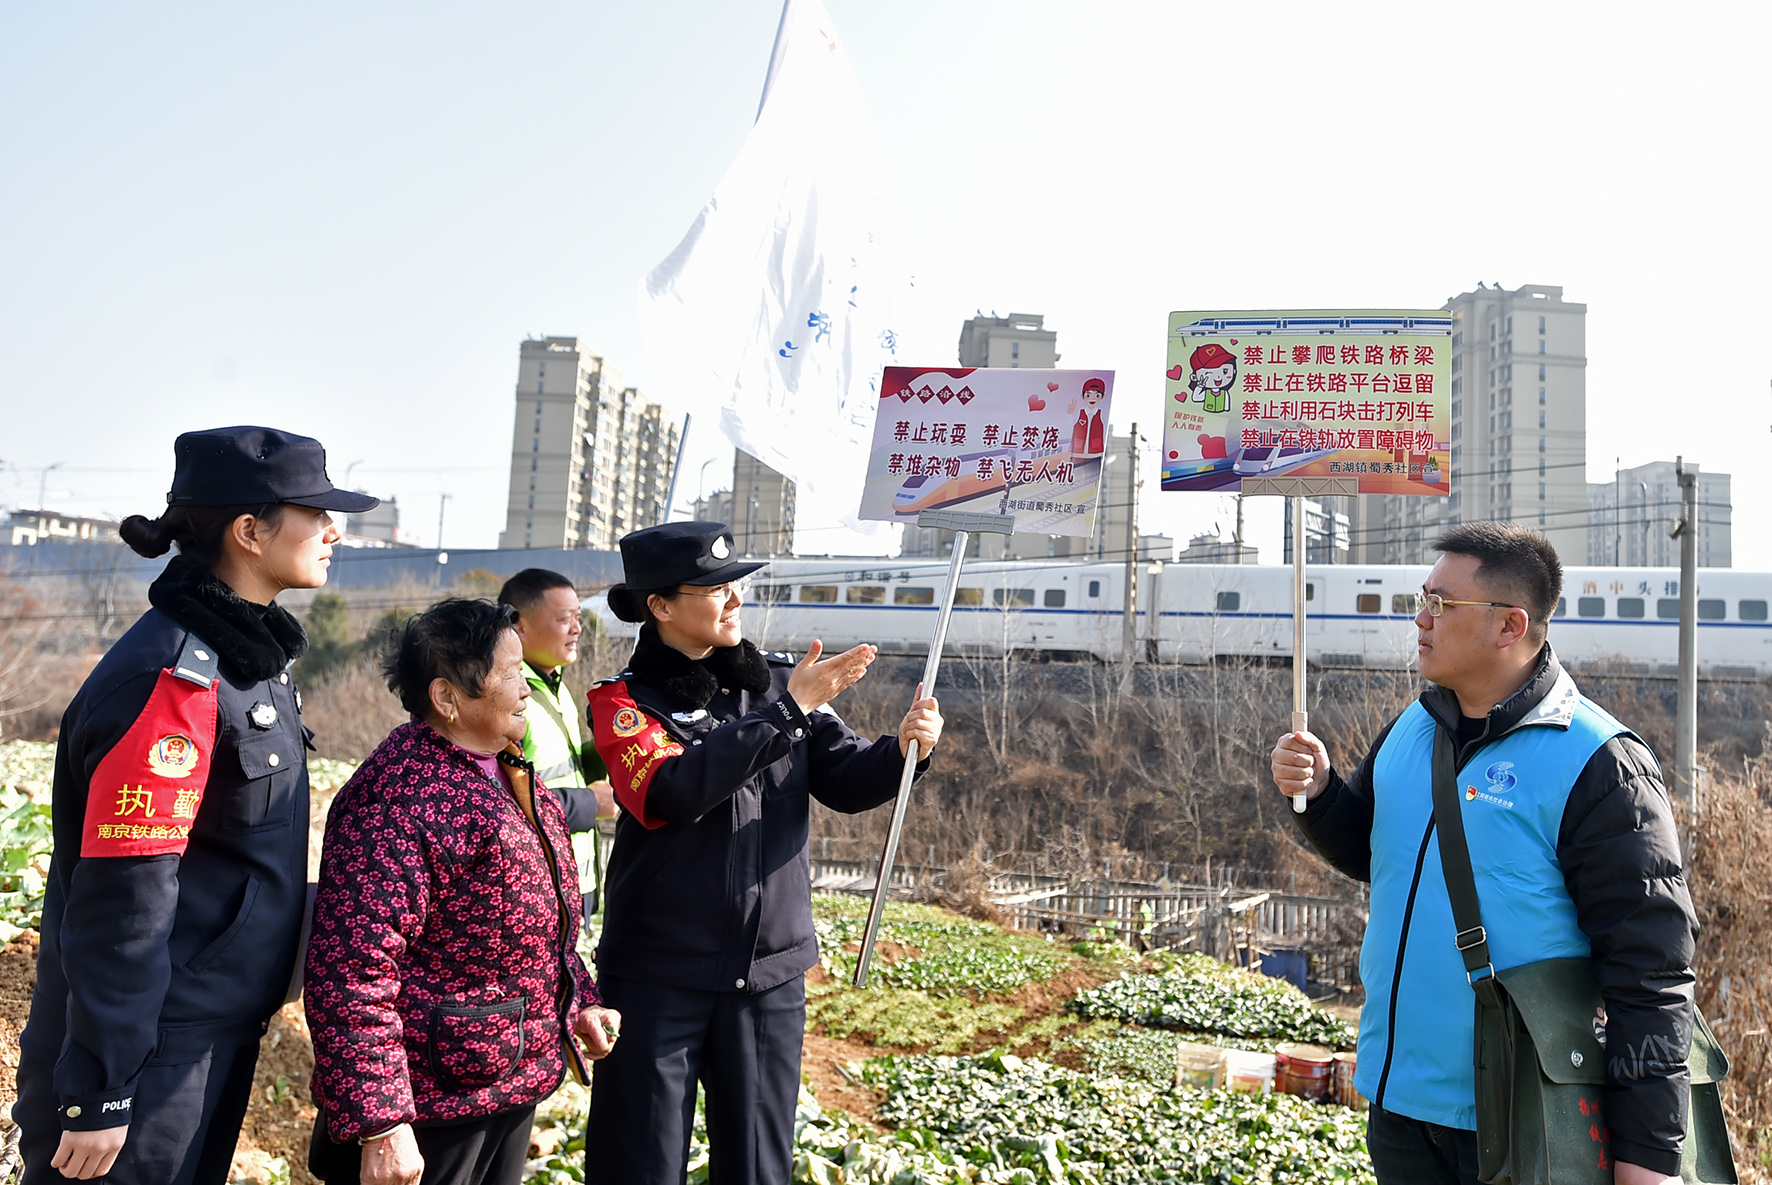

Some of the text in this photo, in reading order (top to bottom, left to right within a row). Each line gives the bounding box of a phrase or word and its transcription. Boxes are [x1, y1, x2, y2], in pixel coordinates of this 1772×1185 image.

[1243, 344, 1434, 366] 禁止攀爬铁路桥梁
[899, 388, 972, 400] 铁路沿线
[1242, 372, 1434, 394] 禁止在铁路平台逗留
[1241, 400, 1434, 422] 禁止利用石块击打列车
[893, 420, 1060, 450] 禁止玩耍 禁止焚烧
[1240, 428, 1434, 451] 禁止在铁轨放置障碍物
[887, 453, 1075, 485] 禁堆杂物 禁飞无人机
[1329, 461, 1435, 475] 西湖镇蜀秀社区宣
[999, 498, 1086, 514] 西湖街道蜀秀社区 宣
[776, 701, 793, 721] POLICE
[102, 1097, 132, 1114] POLICE
